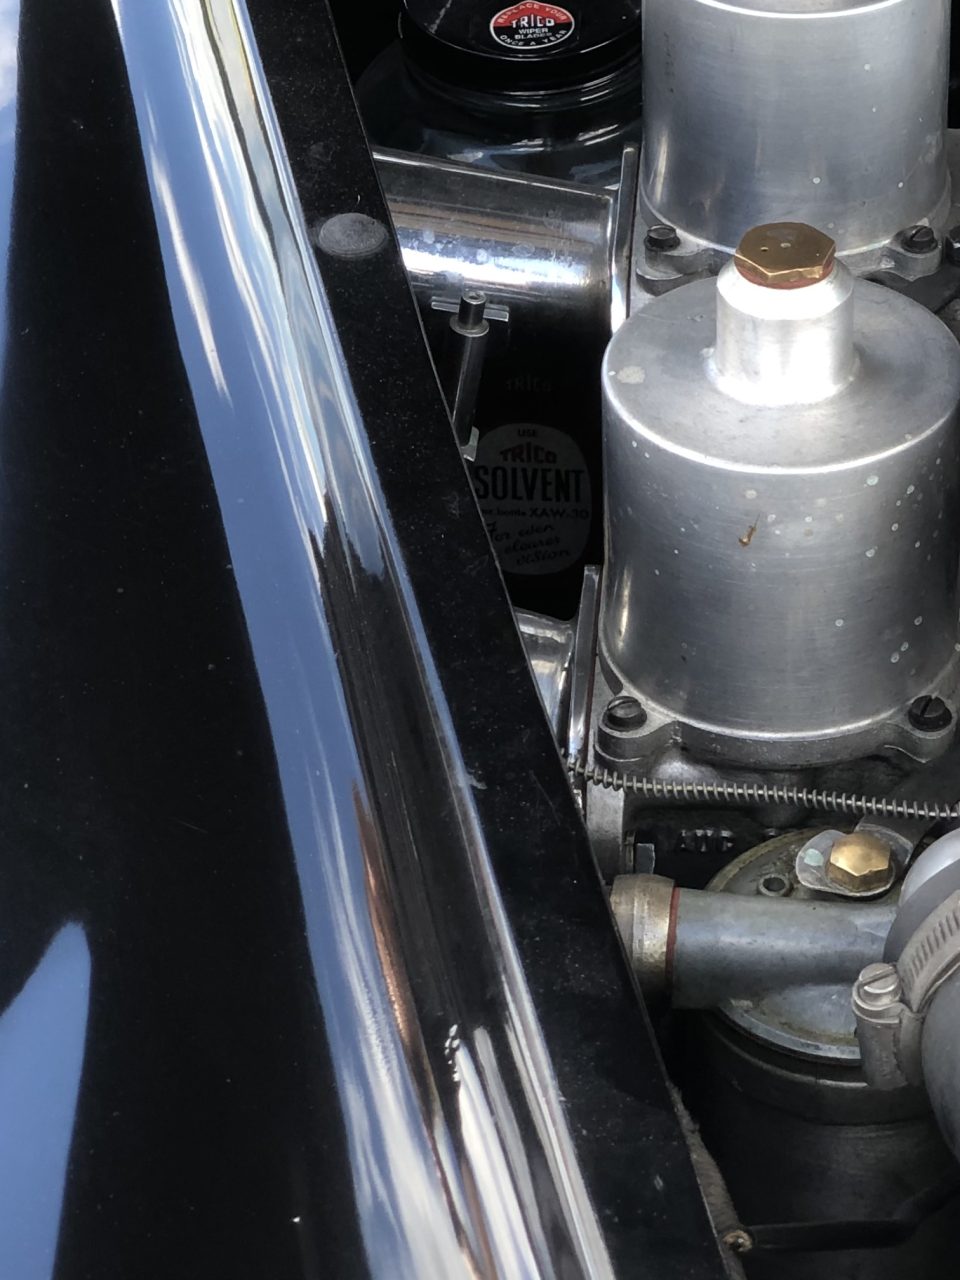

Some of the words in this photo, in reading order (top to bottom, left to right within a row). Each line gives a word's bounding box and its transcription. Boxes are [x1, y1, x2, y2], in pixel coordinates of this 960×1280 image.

[511, 14, 555, 28] TRICO
[545, 7, 568, 21] YOUR
[500, 34, 525, 46] ONCE
[542, 29, 567, 43] YEAR
[514, 32, 552, 40] BLADES
[518, 429, 538, 438] USE
[500, 441, 558, 464] TRICO
[474, 465, 585, 503] SOLVENT
